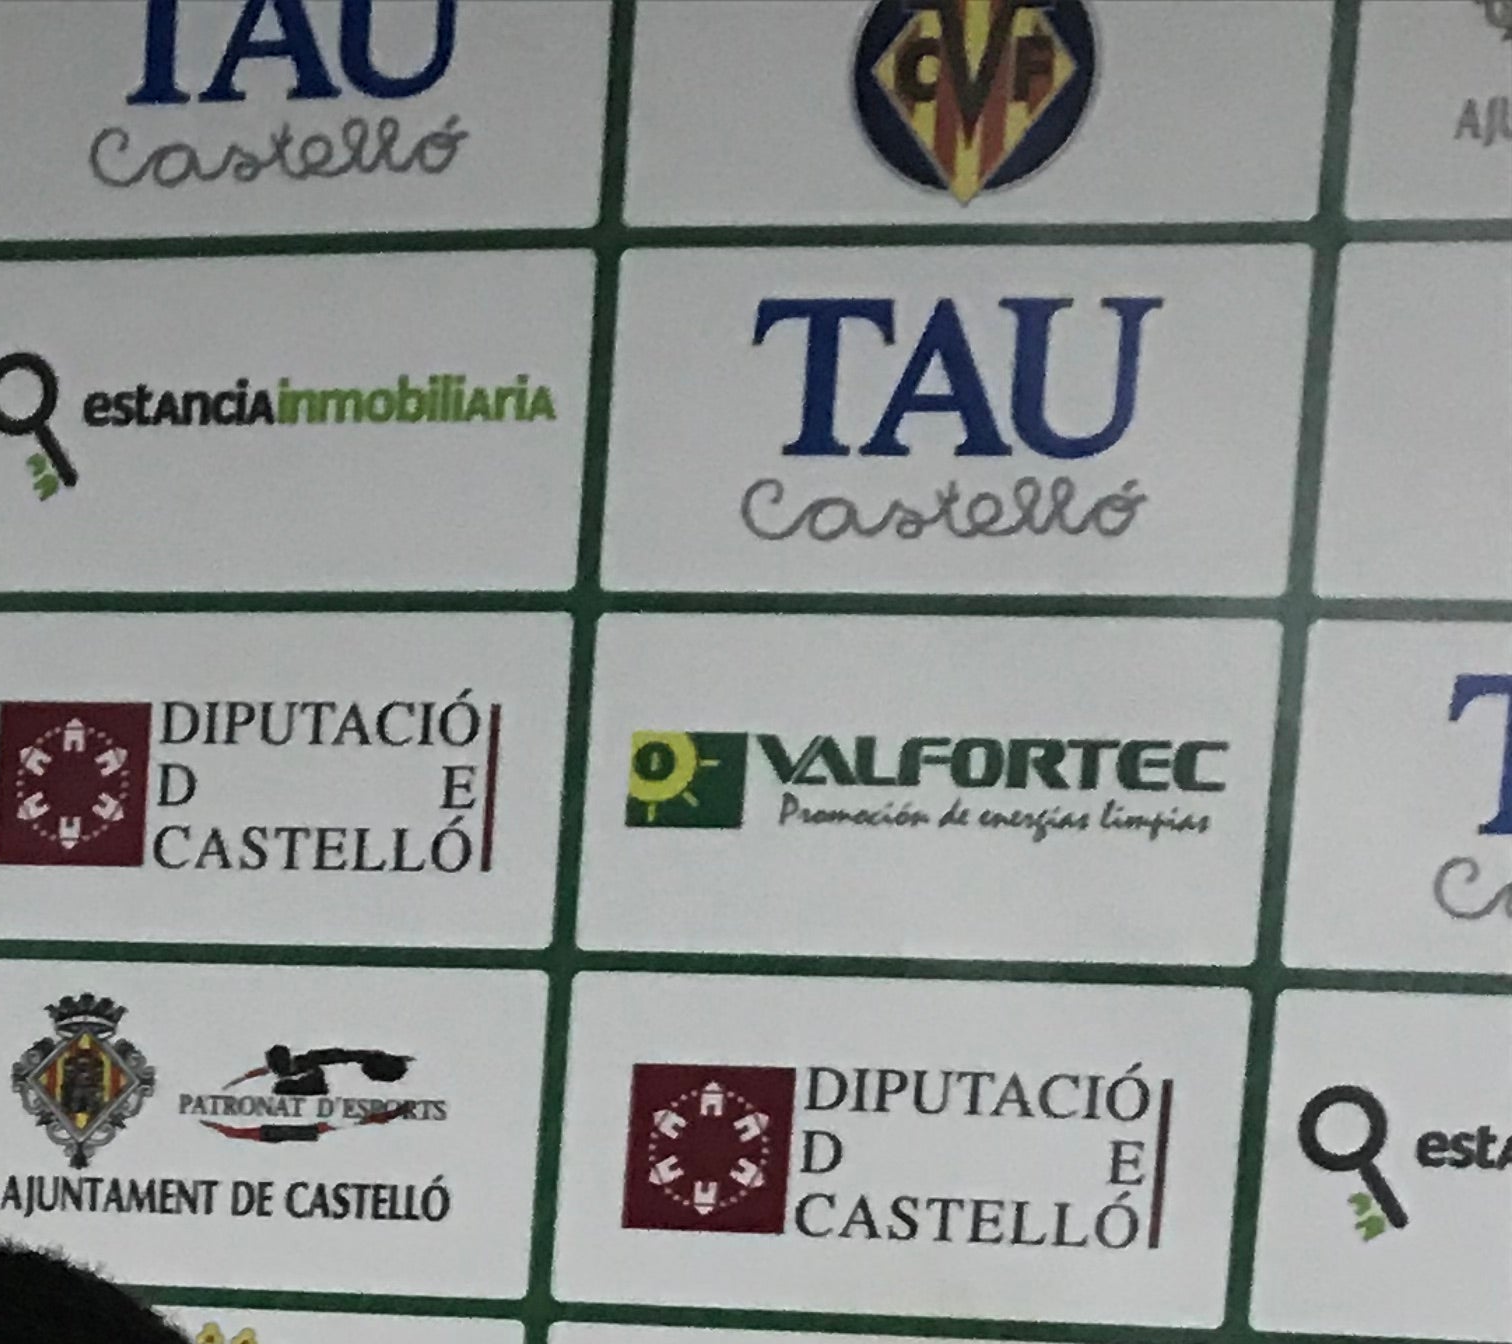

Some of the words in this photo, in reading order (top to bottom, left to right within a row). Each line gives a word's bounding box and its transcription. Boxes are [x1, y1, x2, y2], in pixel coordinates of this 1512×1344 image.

[88, 115, 469, 189] Castelló
[752, 298, 1163, 459] TAU
[740, 476, 1147, 542] Castelló
[160, 688, 480, 747] DIPUTACIÓ
[158, 763, 197, 806] D
[440, 766, 476, 809] E
[756, 734, 1229, 792] VALFORTEC
[938, 798, 969, 828] de
[153, 815, 472, 873] CASTELLÓ
[179, 1094, 305, 1118] PATRONAT
[804, 1062, 1150, 1122] DIPUTACIÓ
[800, 1130, 843, 1174] D
[1108, 1140, 1145, 1185] E
[1, 1175, 219, 1217] AJUNTAMENT
[231, 1181, 274, 1217] DE
[285, 1175, 450, 1222] CASTELLÓ
[795, 1191, 1139, 1249] CASTELLÓ
